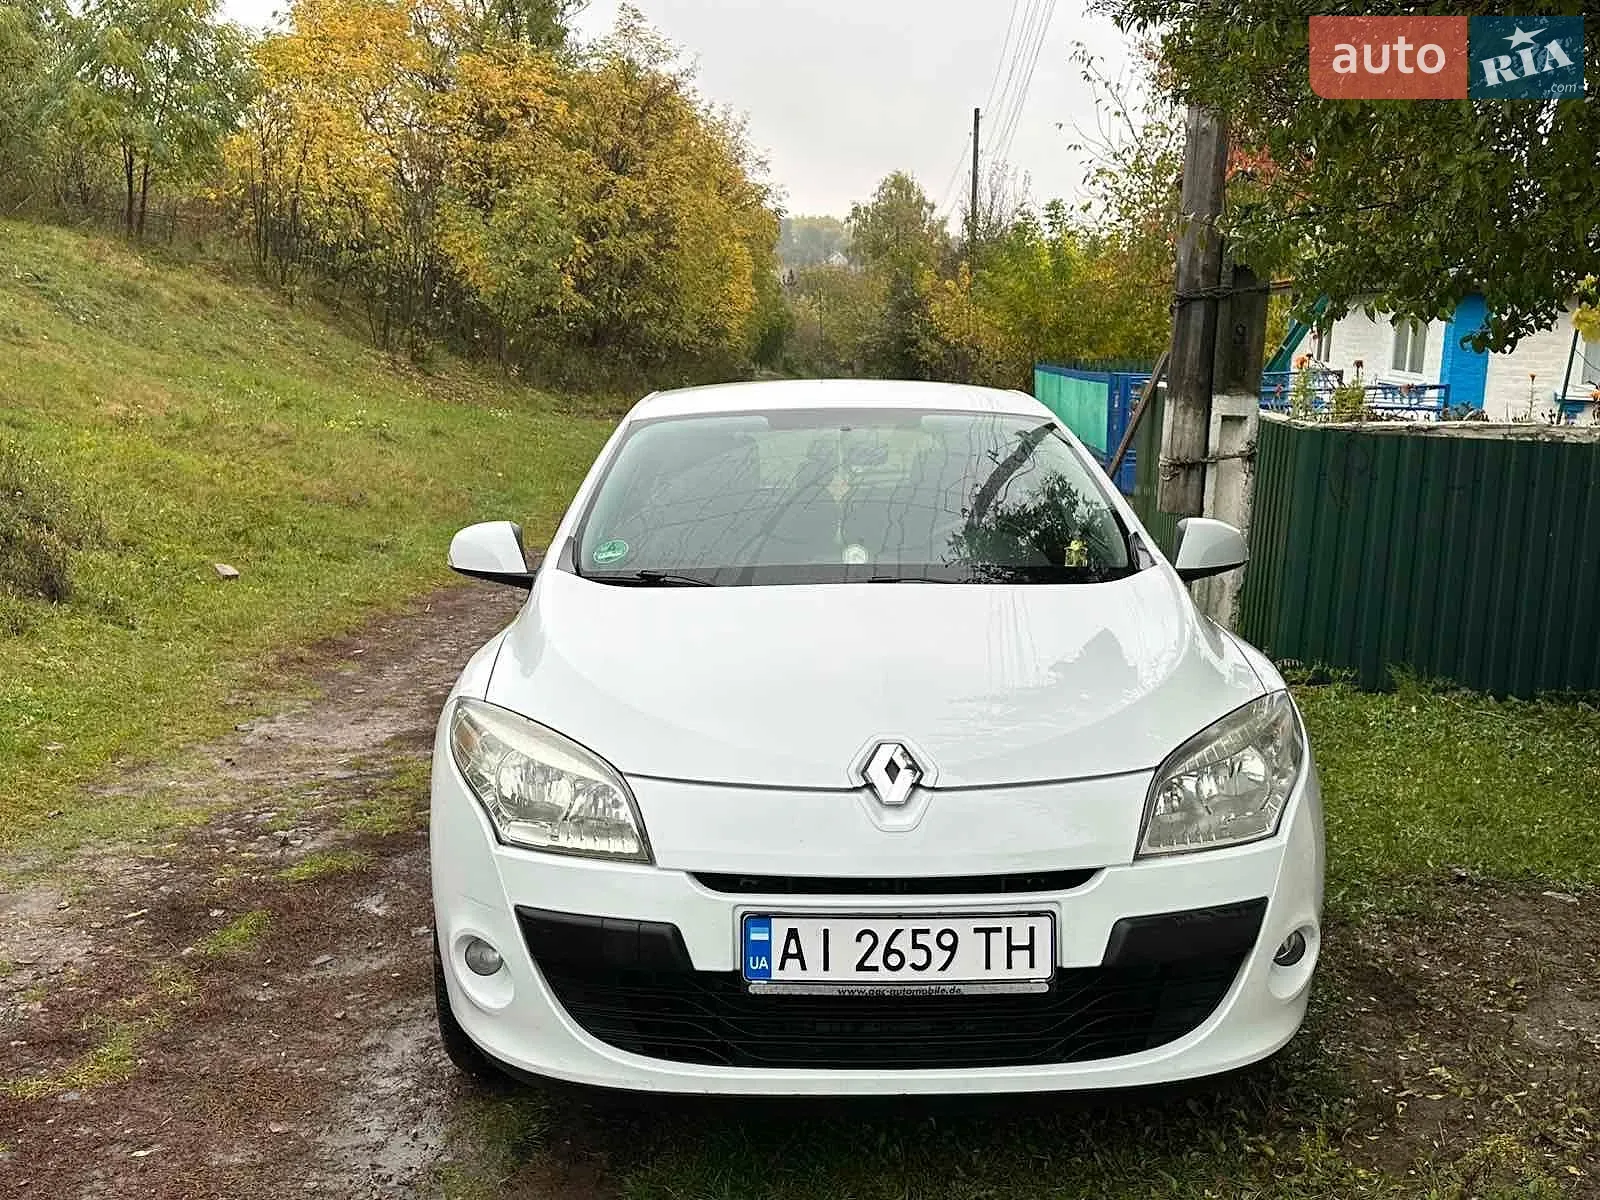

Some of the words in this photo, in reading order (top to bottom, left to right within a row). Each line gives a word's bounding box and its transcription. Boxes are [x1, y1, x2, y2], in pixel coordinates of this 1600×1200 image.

[750, 956, 769, 970] UA
[778, 927, 830, 971] AI
[855, 928, 959, 972] 2659
[973, 926, 1036, 970] TH
